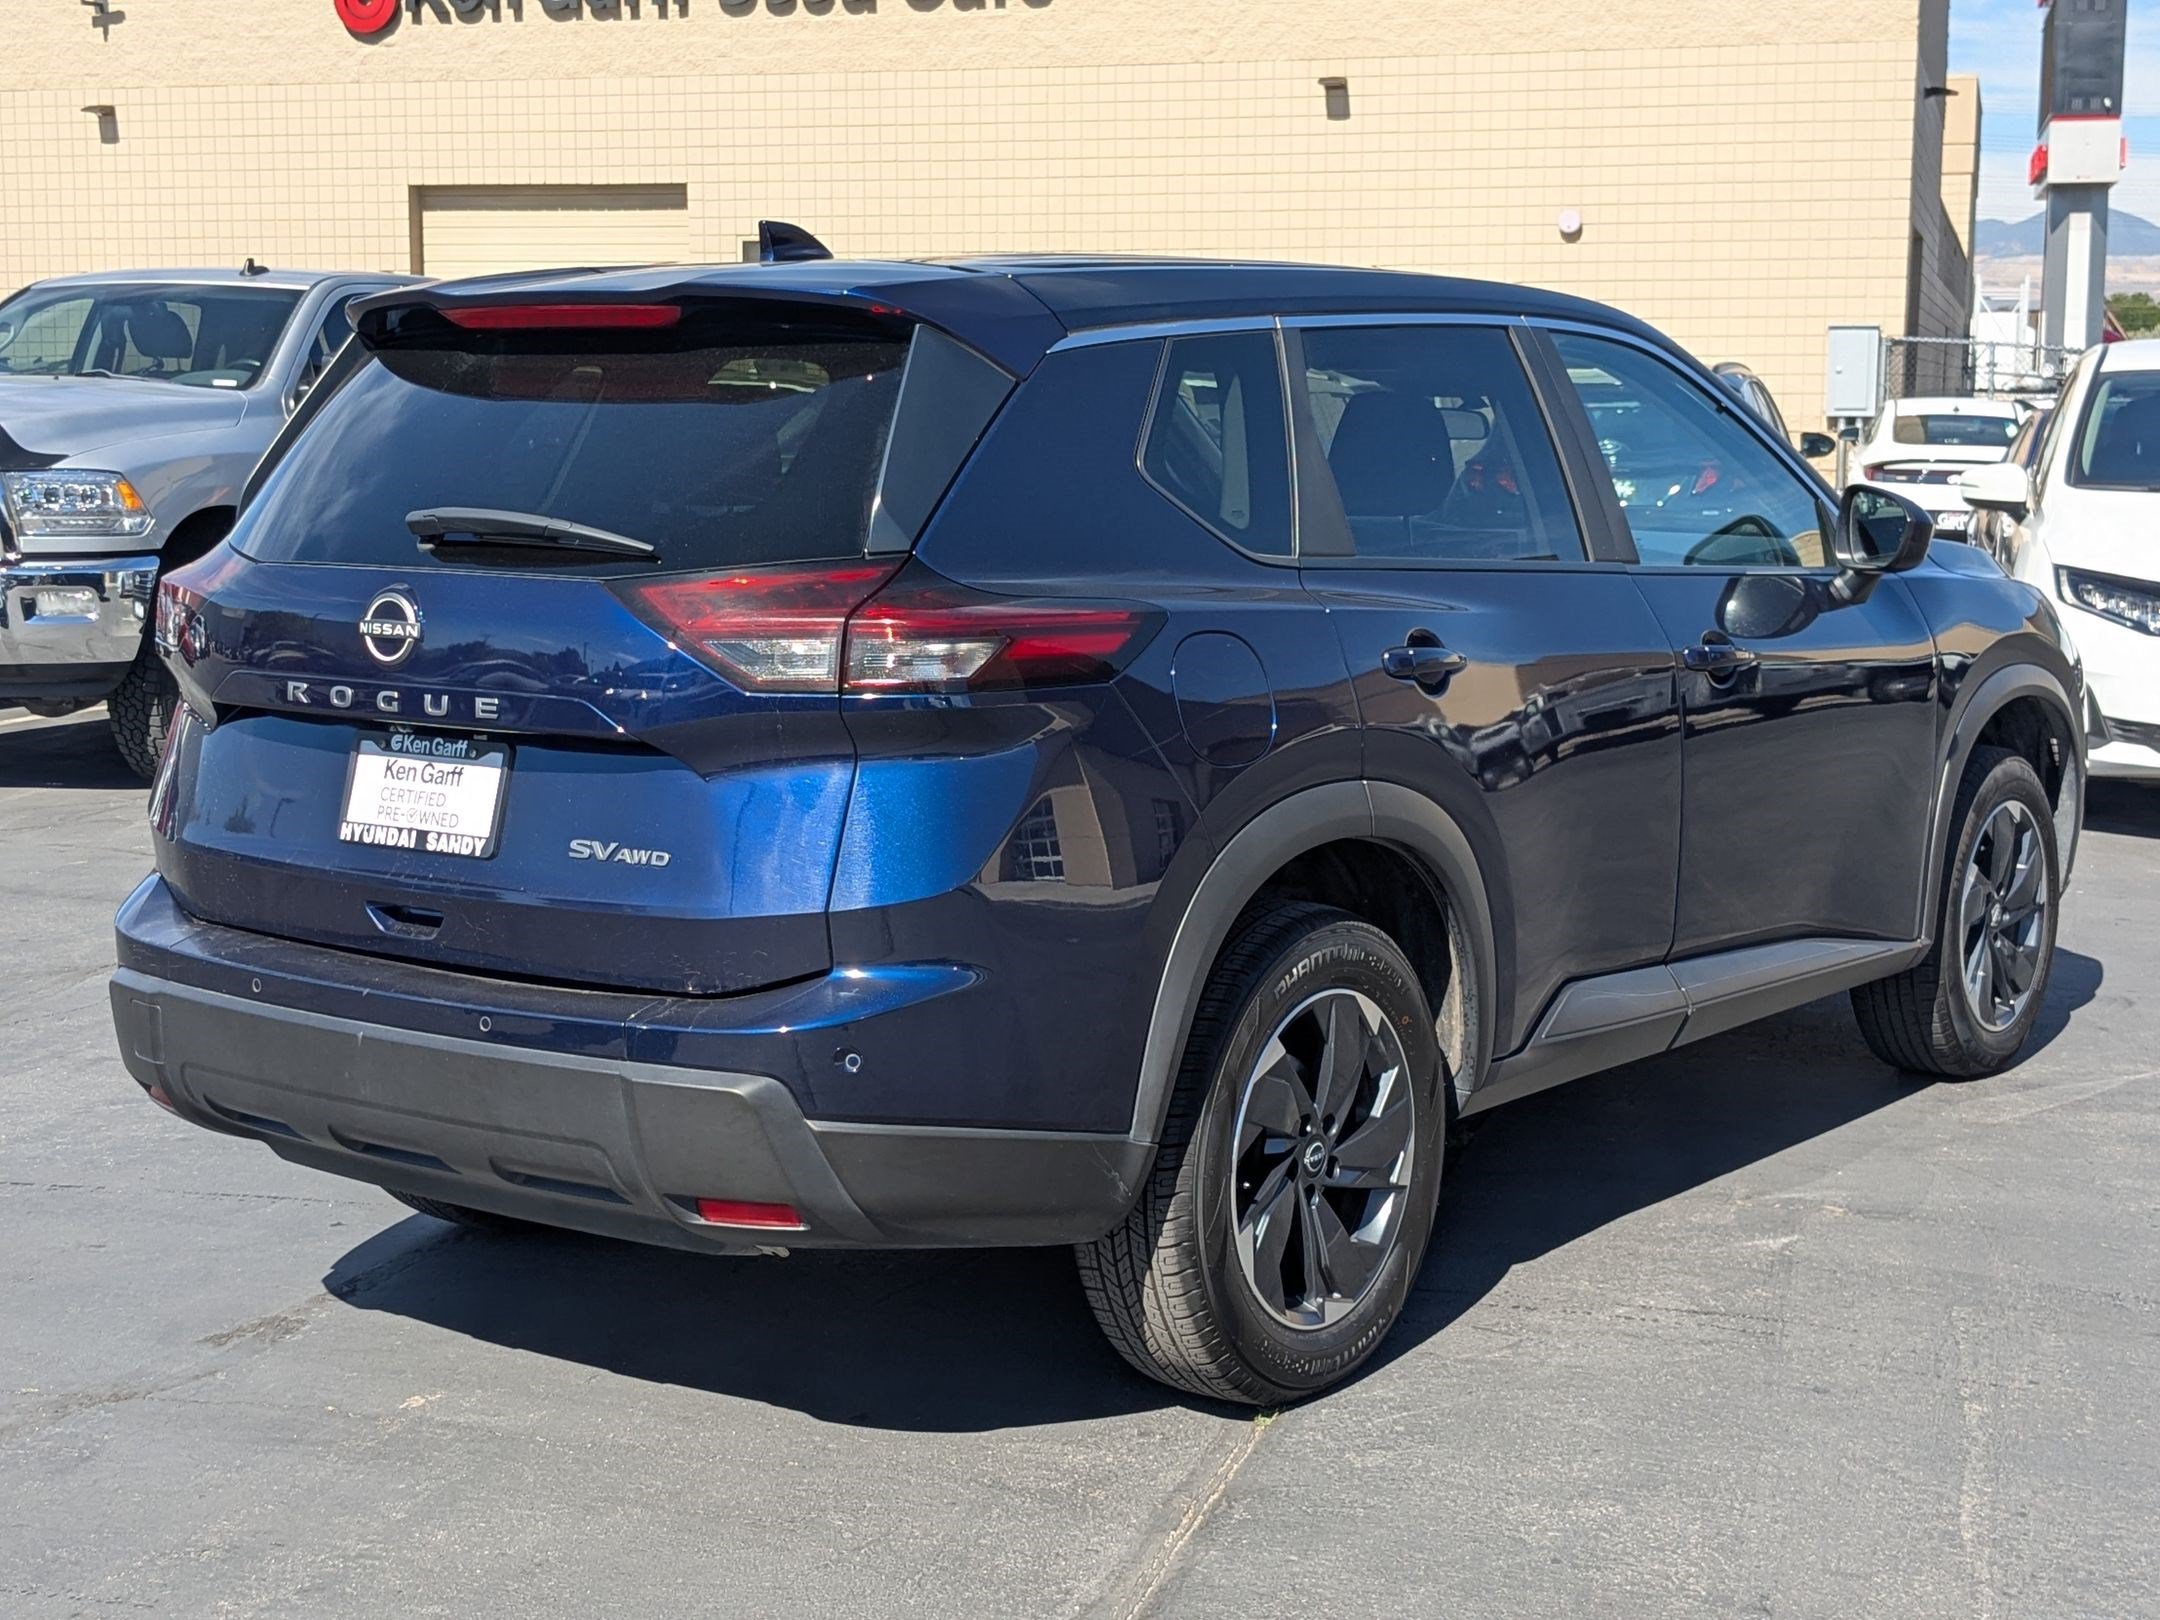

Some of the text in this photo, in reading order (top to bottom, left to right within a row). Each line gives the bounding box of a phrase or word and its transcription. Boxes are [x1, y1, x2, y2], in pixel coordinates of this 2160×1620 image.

[359, 621, 418, 638] NISSAN
[286, 680, 500, 721] ROGUE
[403, 735, 430, 755] Ken
[432, 737, 469, 758] Garff
[384, 759, 464, 787] Ken Garff
[380, 786, 447, 808] CERTIFIED
[339, 822, 487, 857] HYUNDAI SANDY
[568, 839, 671, 867] SV AWD
